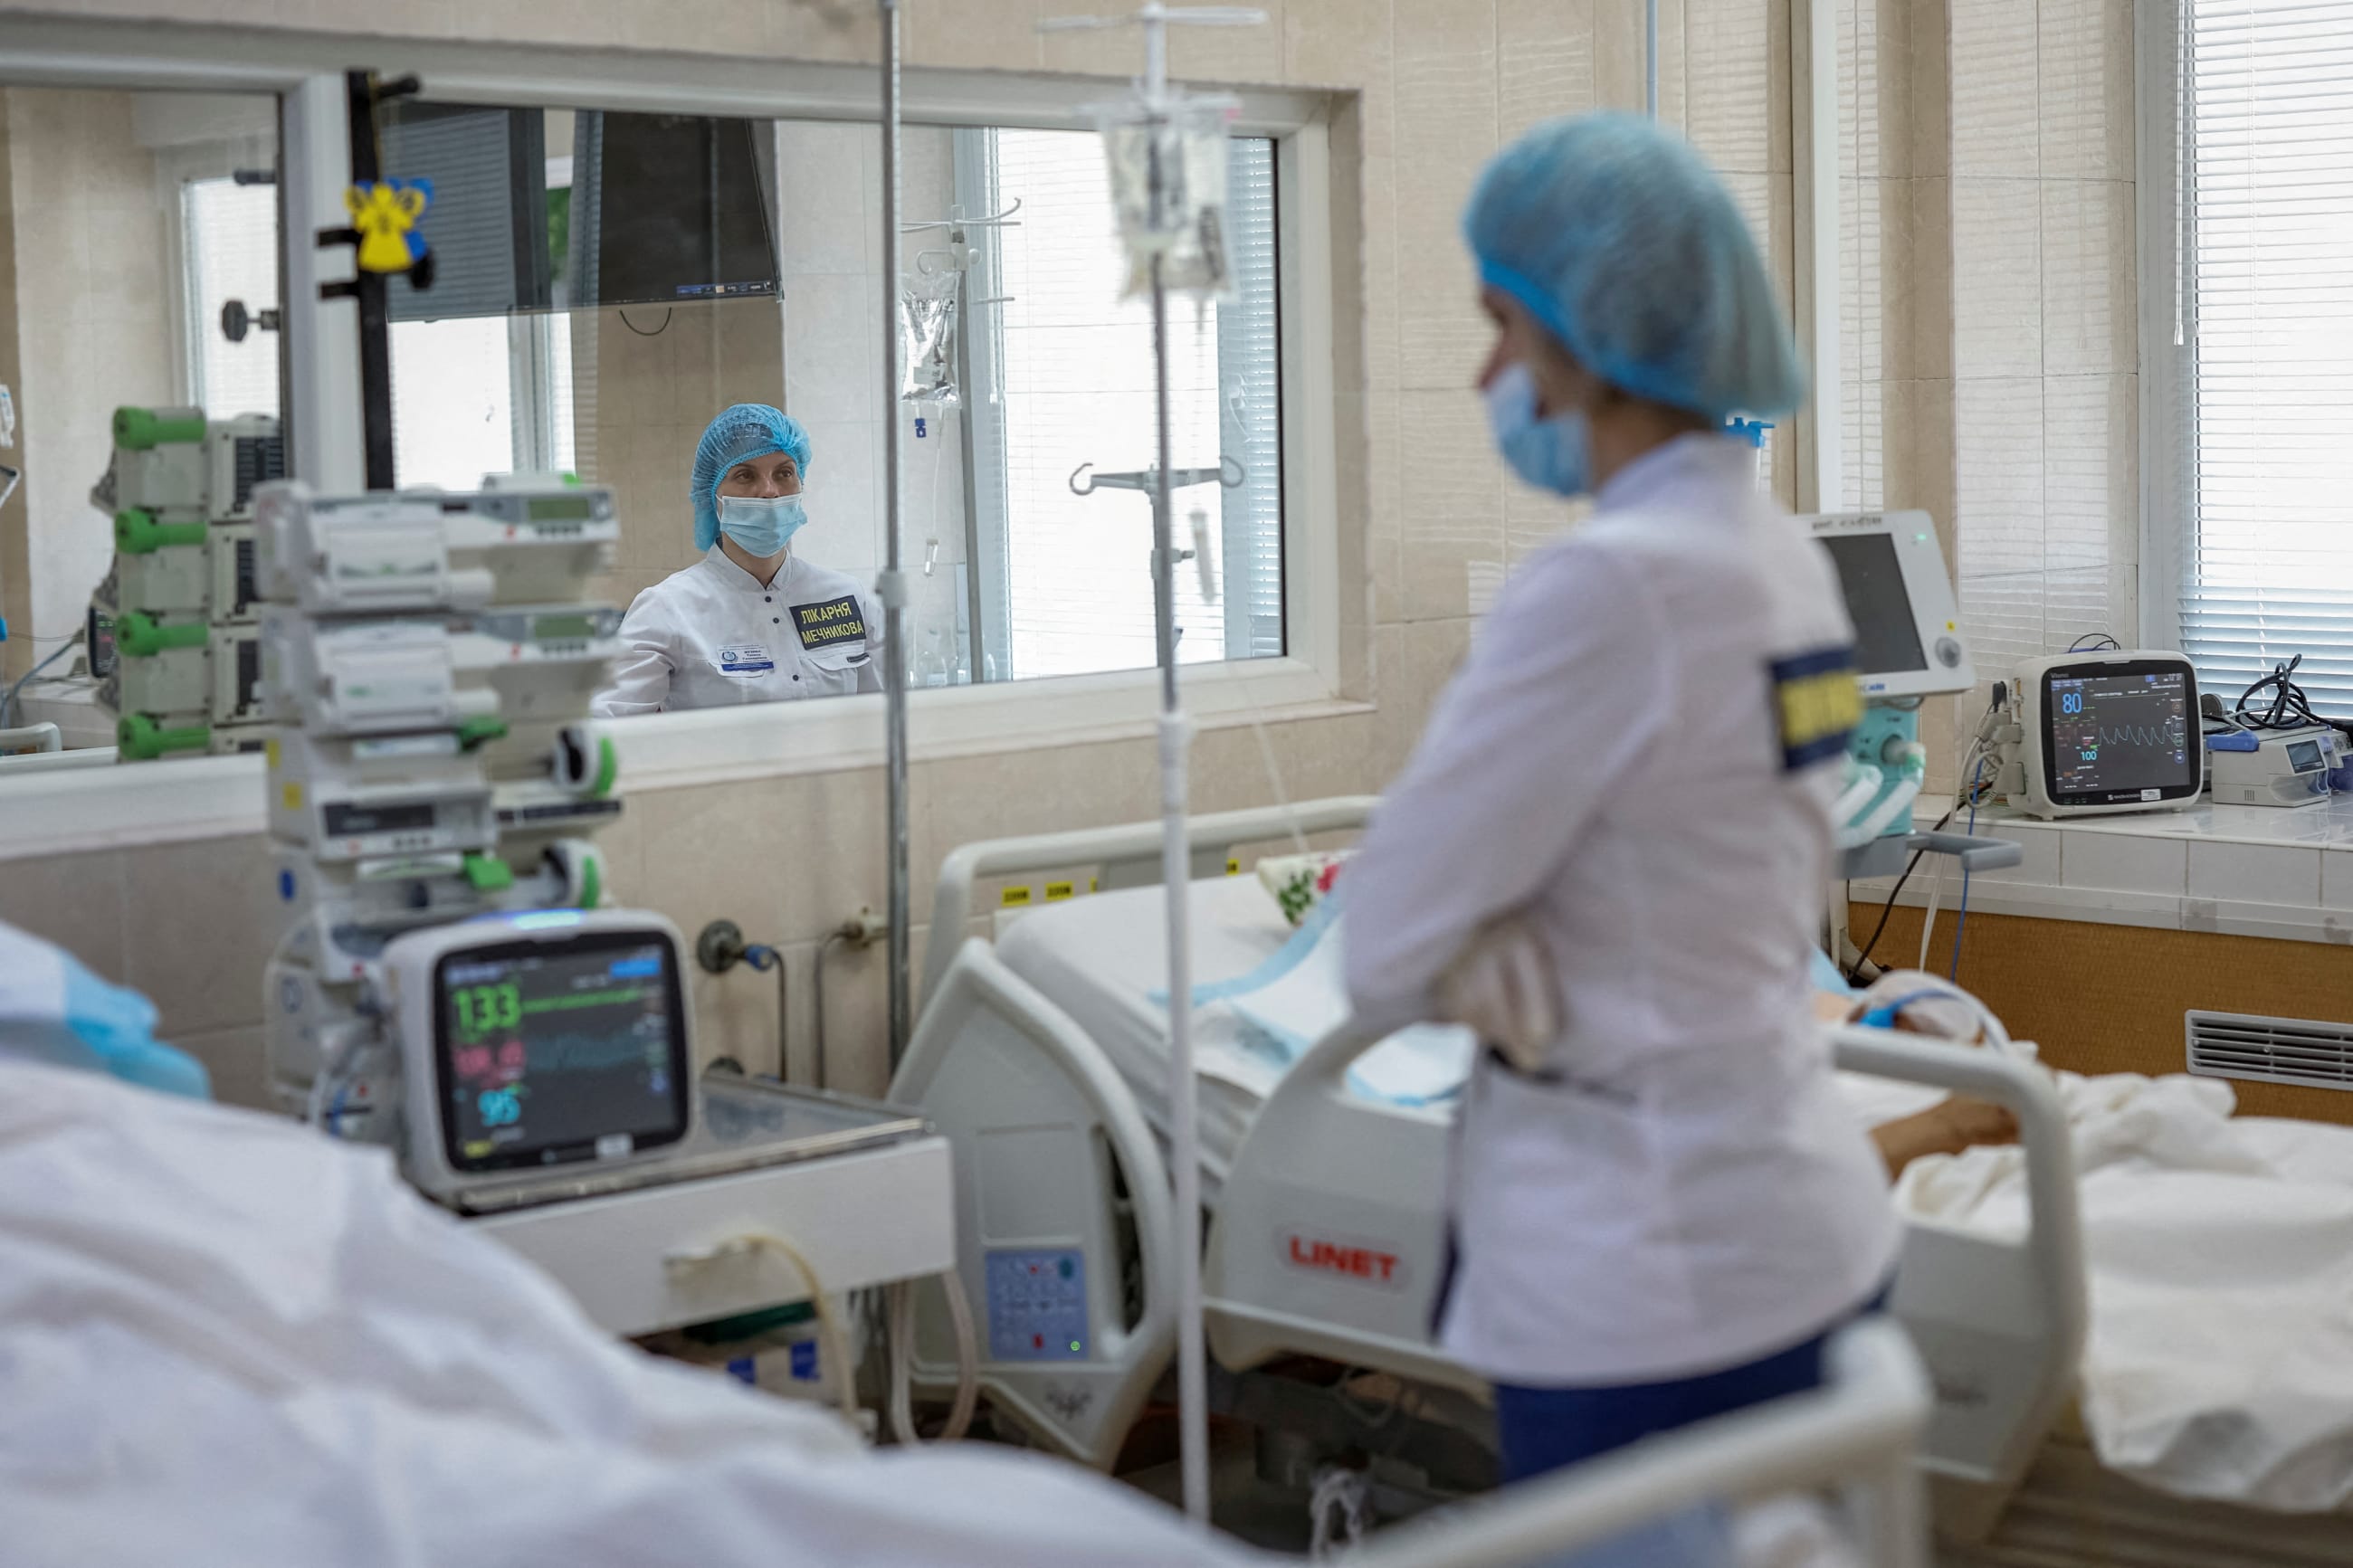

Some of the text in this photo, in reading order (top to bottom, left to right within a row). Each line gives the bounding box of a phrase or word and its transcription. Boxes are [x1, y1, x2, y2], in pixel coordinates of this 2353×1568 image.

[800, 602, 853, 624] ЛІКАРНЯ
[801, 620, 864, 644] МЕЧНИКОВА
[2062, 693, 2082, 714] 80
[2081, 751, 2097, 761] 100
[455, 984, 521, 1032] 133
[1290, 1236, 1398, 1281] LINET
